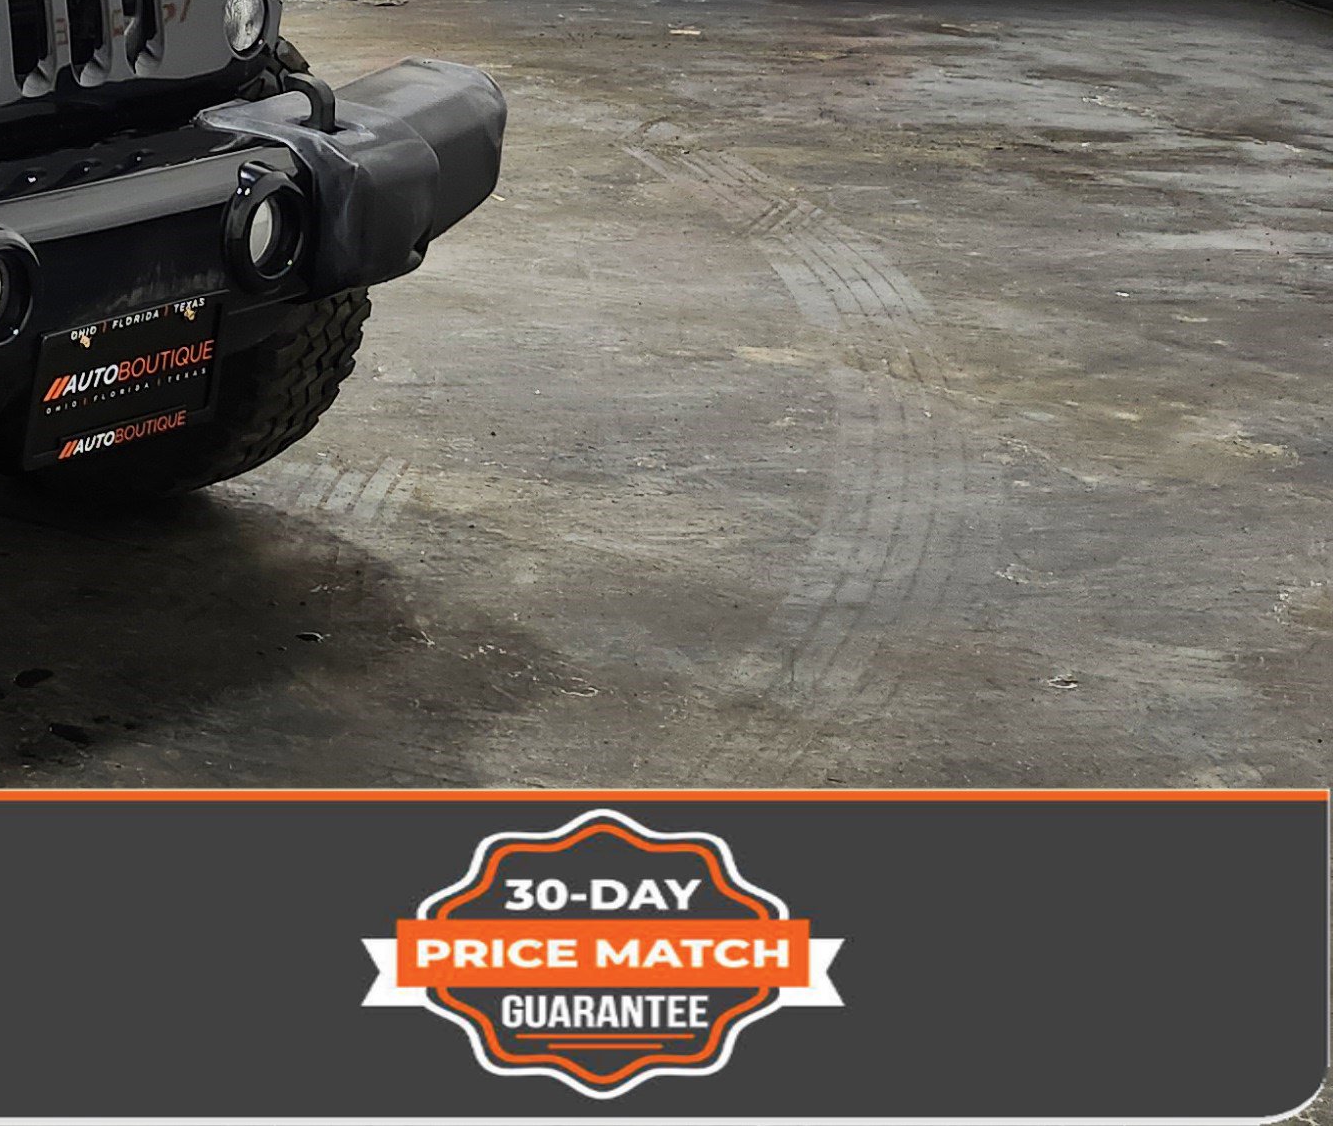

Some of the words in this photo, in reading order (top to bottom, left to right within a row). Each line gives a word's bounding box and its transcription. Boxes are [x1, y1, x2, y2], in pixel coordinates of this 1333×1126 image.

[70, 326, 98, 342] OHIO
[111, 309, 160, 330] FLORIDA
[173, 297, 206, 314] TEXAS
[46, 400, 78, 415] OHIO
[93, 383, 150, 403] FLORIDA
[167, 367, 207, 384] TEXAS
